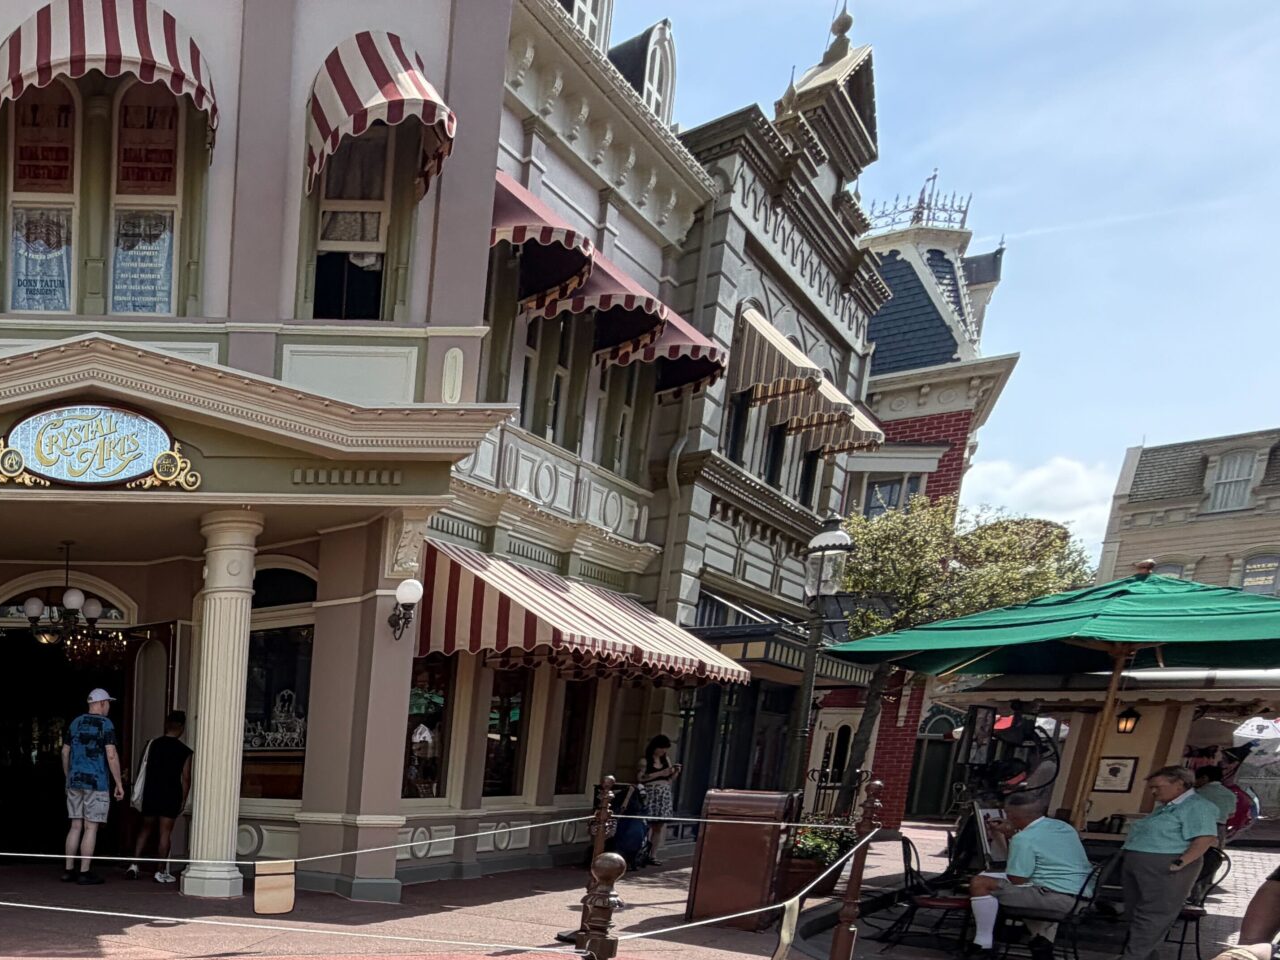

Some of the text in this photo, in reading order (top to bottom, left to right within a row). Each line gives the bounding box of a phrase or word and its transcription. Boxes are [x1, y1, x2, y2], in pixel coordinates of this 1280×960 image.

[17, 278, 65, 288] DONN TATUM
[25, 288, 57, 296] PRESIDENT
